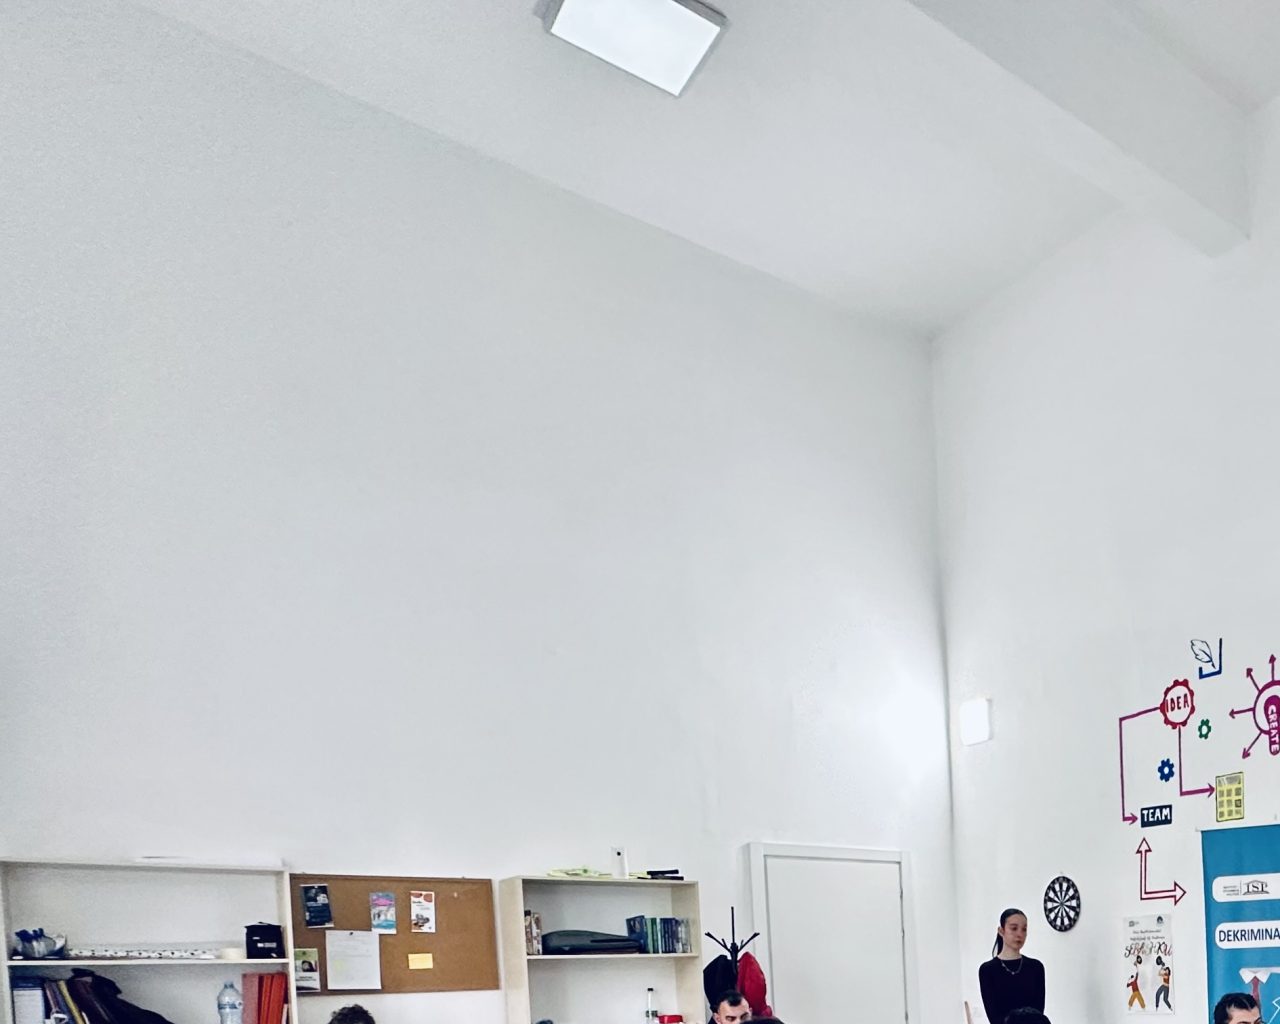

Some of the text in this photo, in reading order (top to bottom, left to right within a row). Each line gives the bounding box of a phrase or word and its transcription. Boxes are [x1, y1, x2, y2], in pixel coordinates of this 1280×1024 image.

[1165, 693, 1190, 713] IDEA
[1267, 704, 1280, 752] CREATE
[1142, 807, 1171, 822] TEAM
